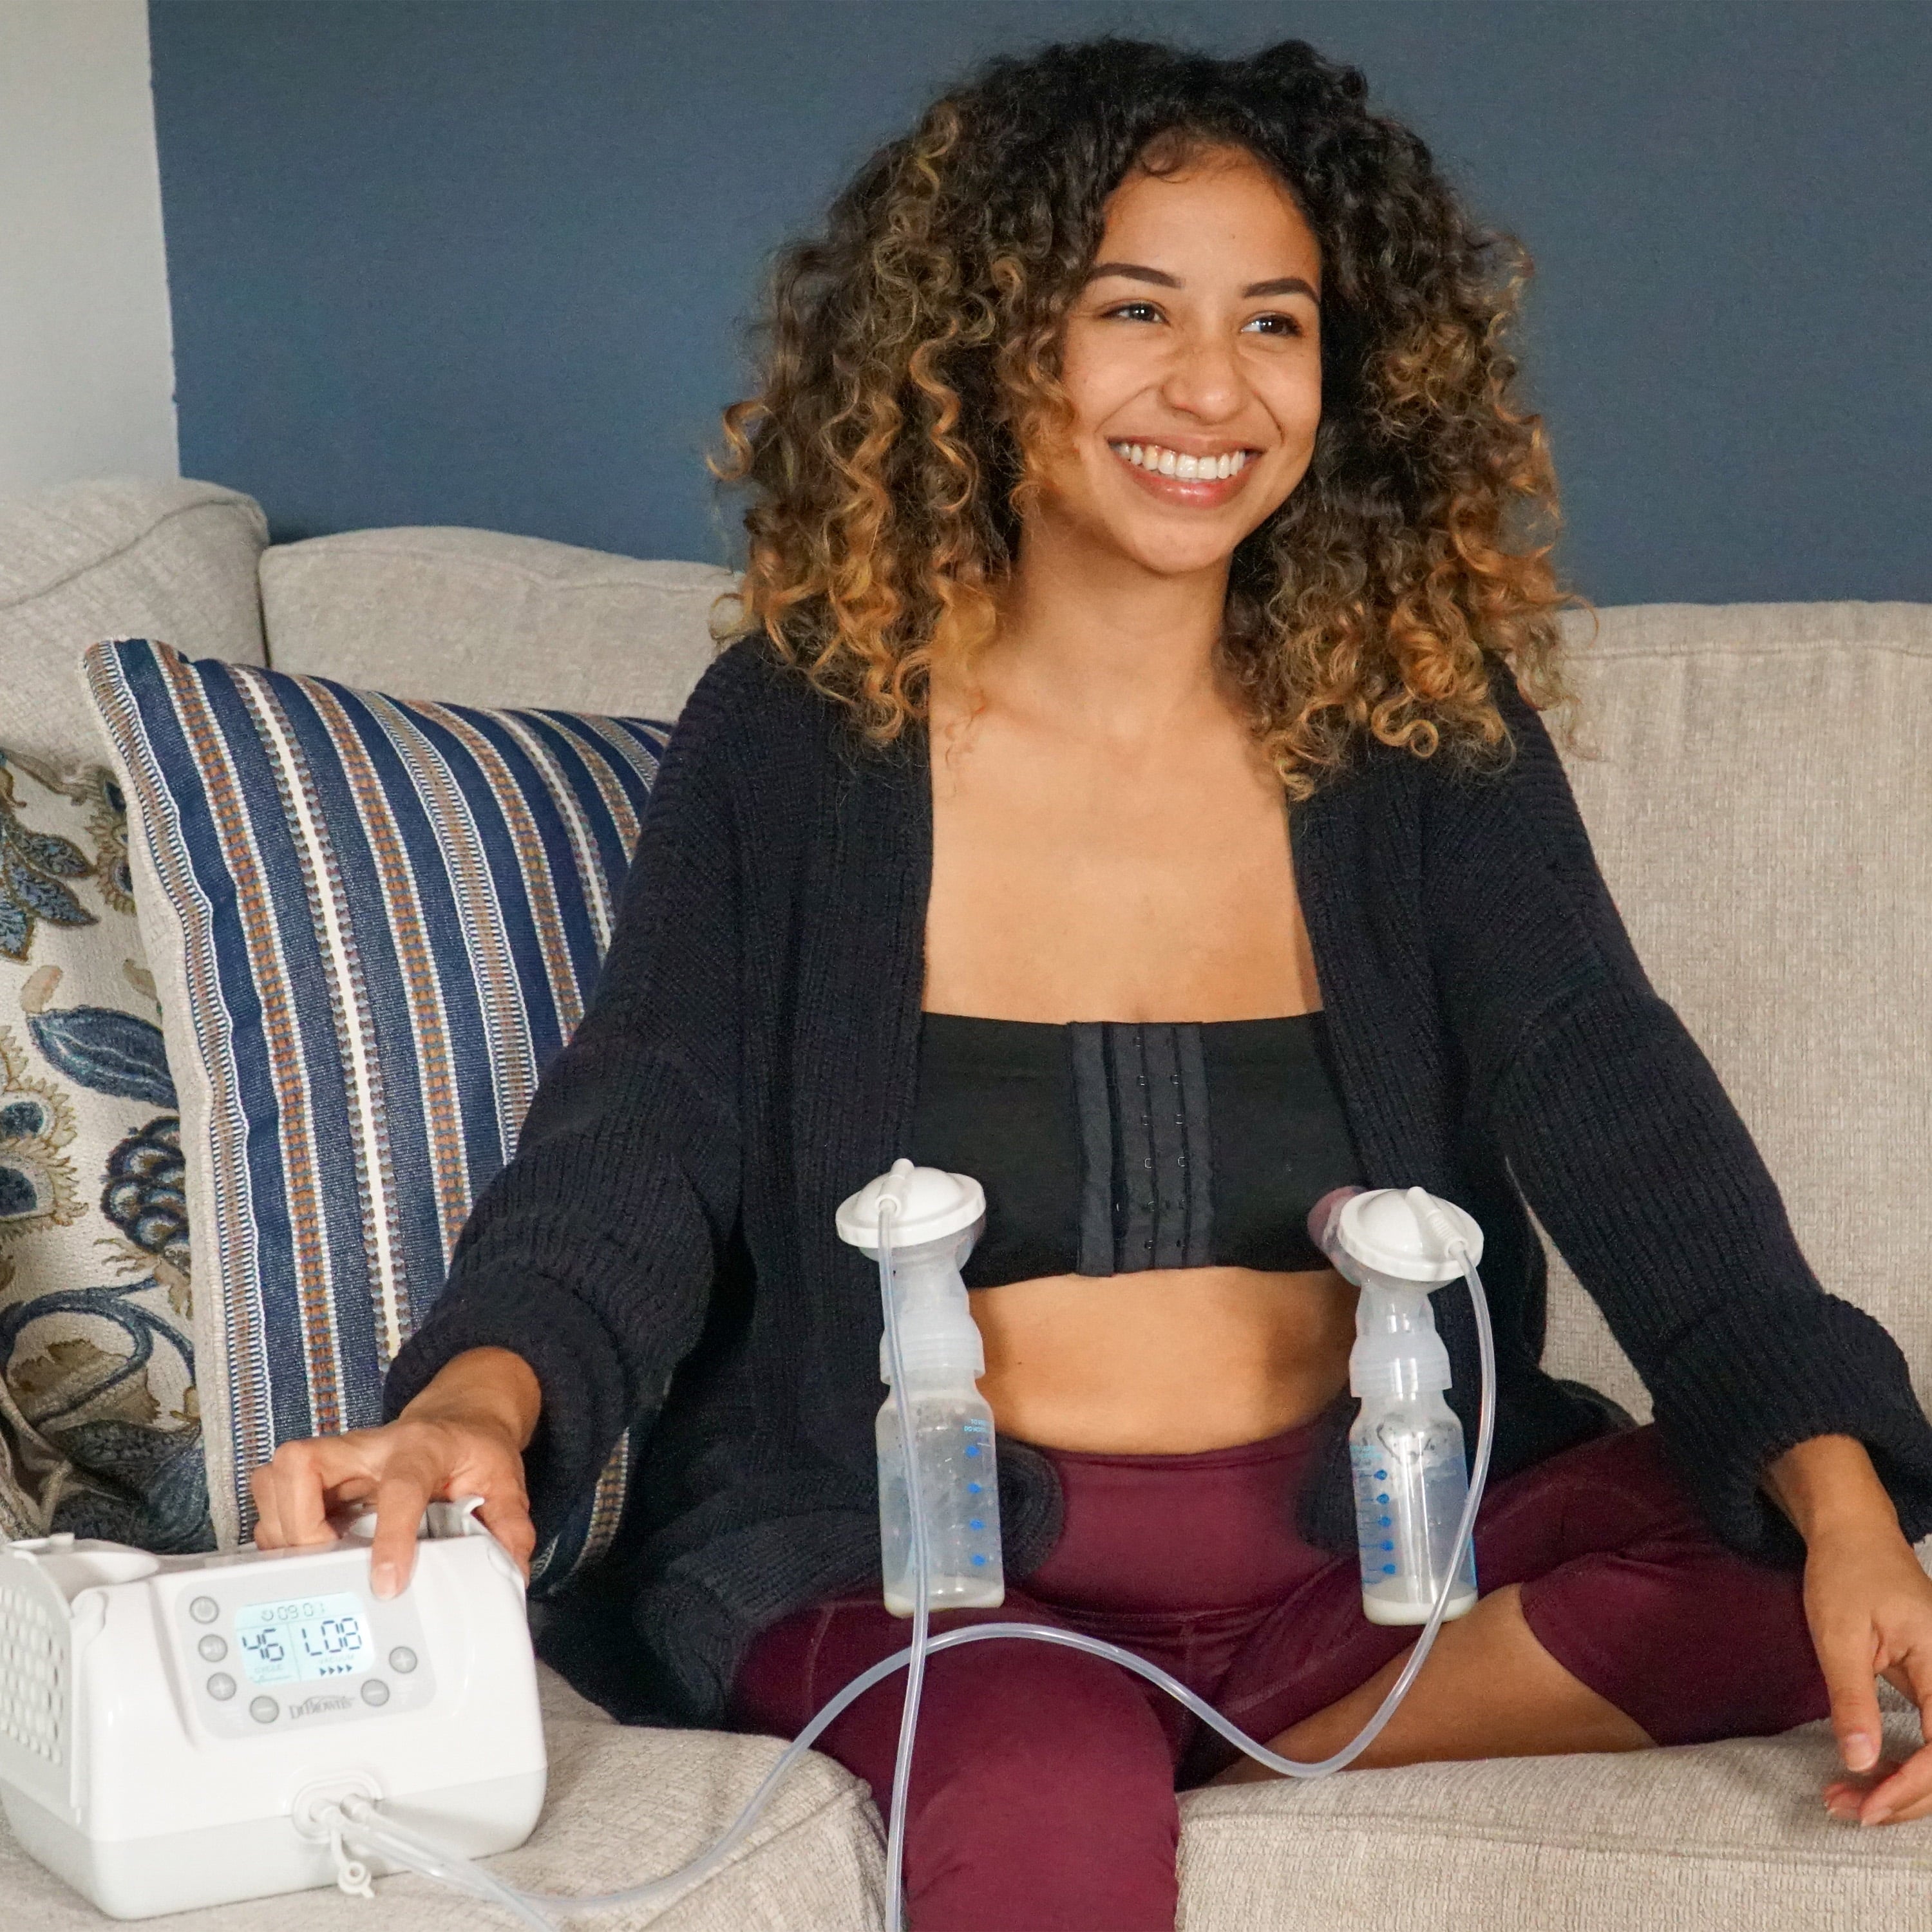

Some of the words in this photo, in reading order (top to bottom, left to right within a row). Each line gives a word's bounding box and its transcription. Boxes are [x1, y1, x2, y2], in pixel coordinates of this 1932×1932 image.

[242, 1627, 285, 1662] 46
[319, 1654, 355, 1664] VACUUM
[254, 1665, 284, 1674] CYCLE
